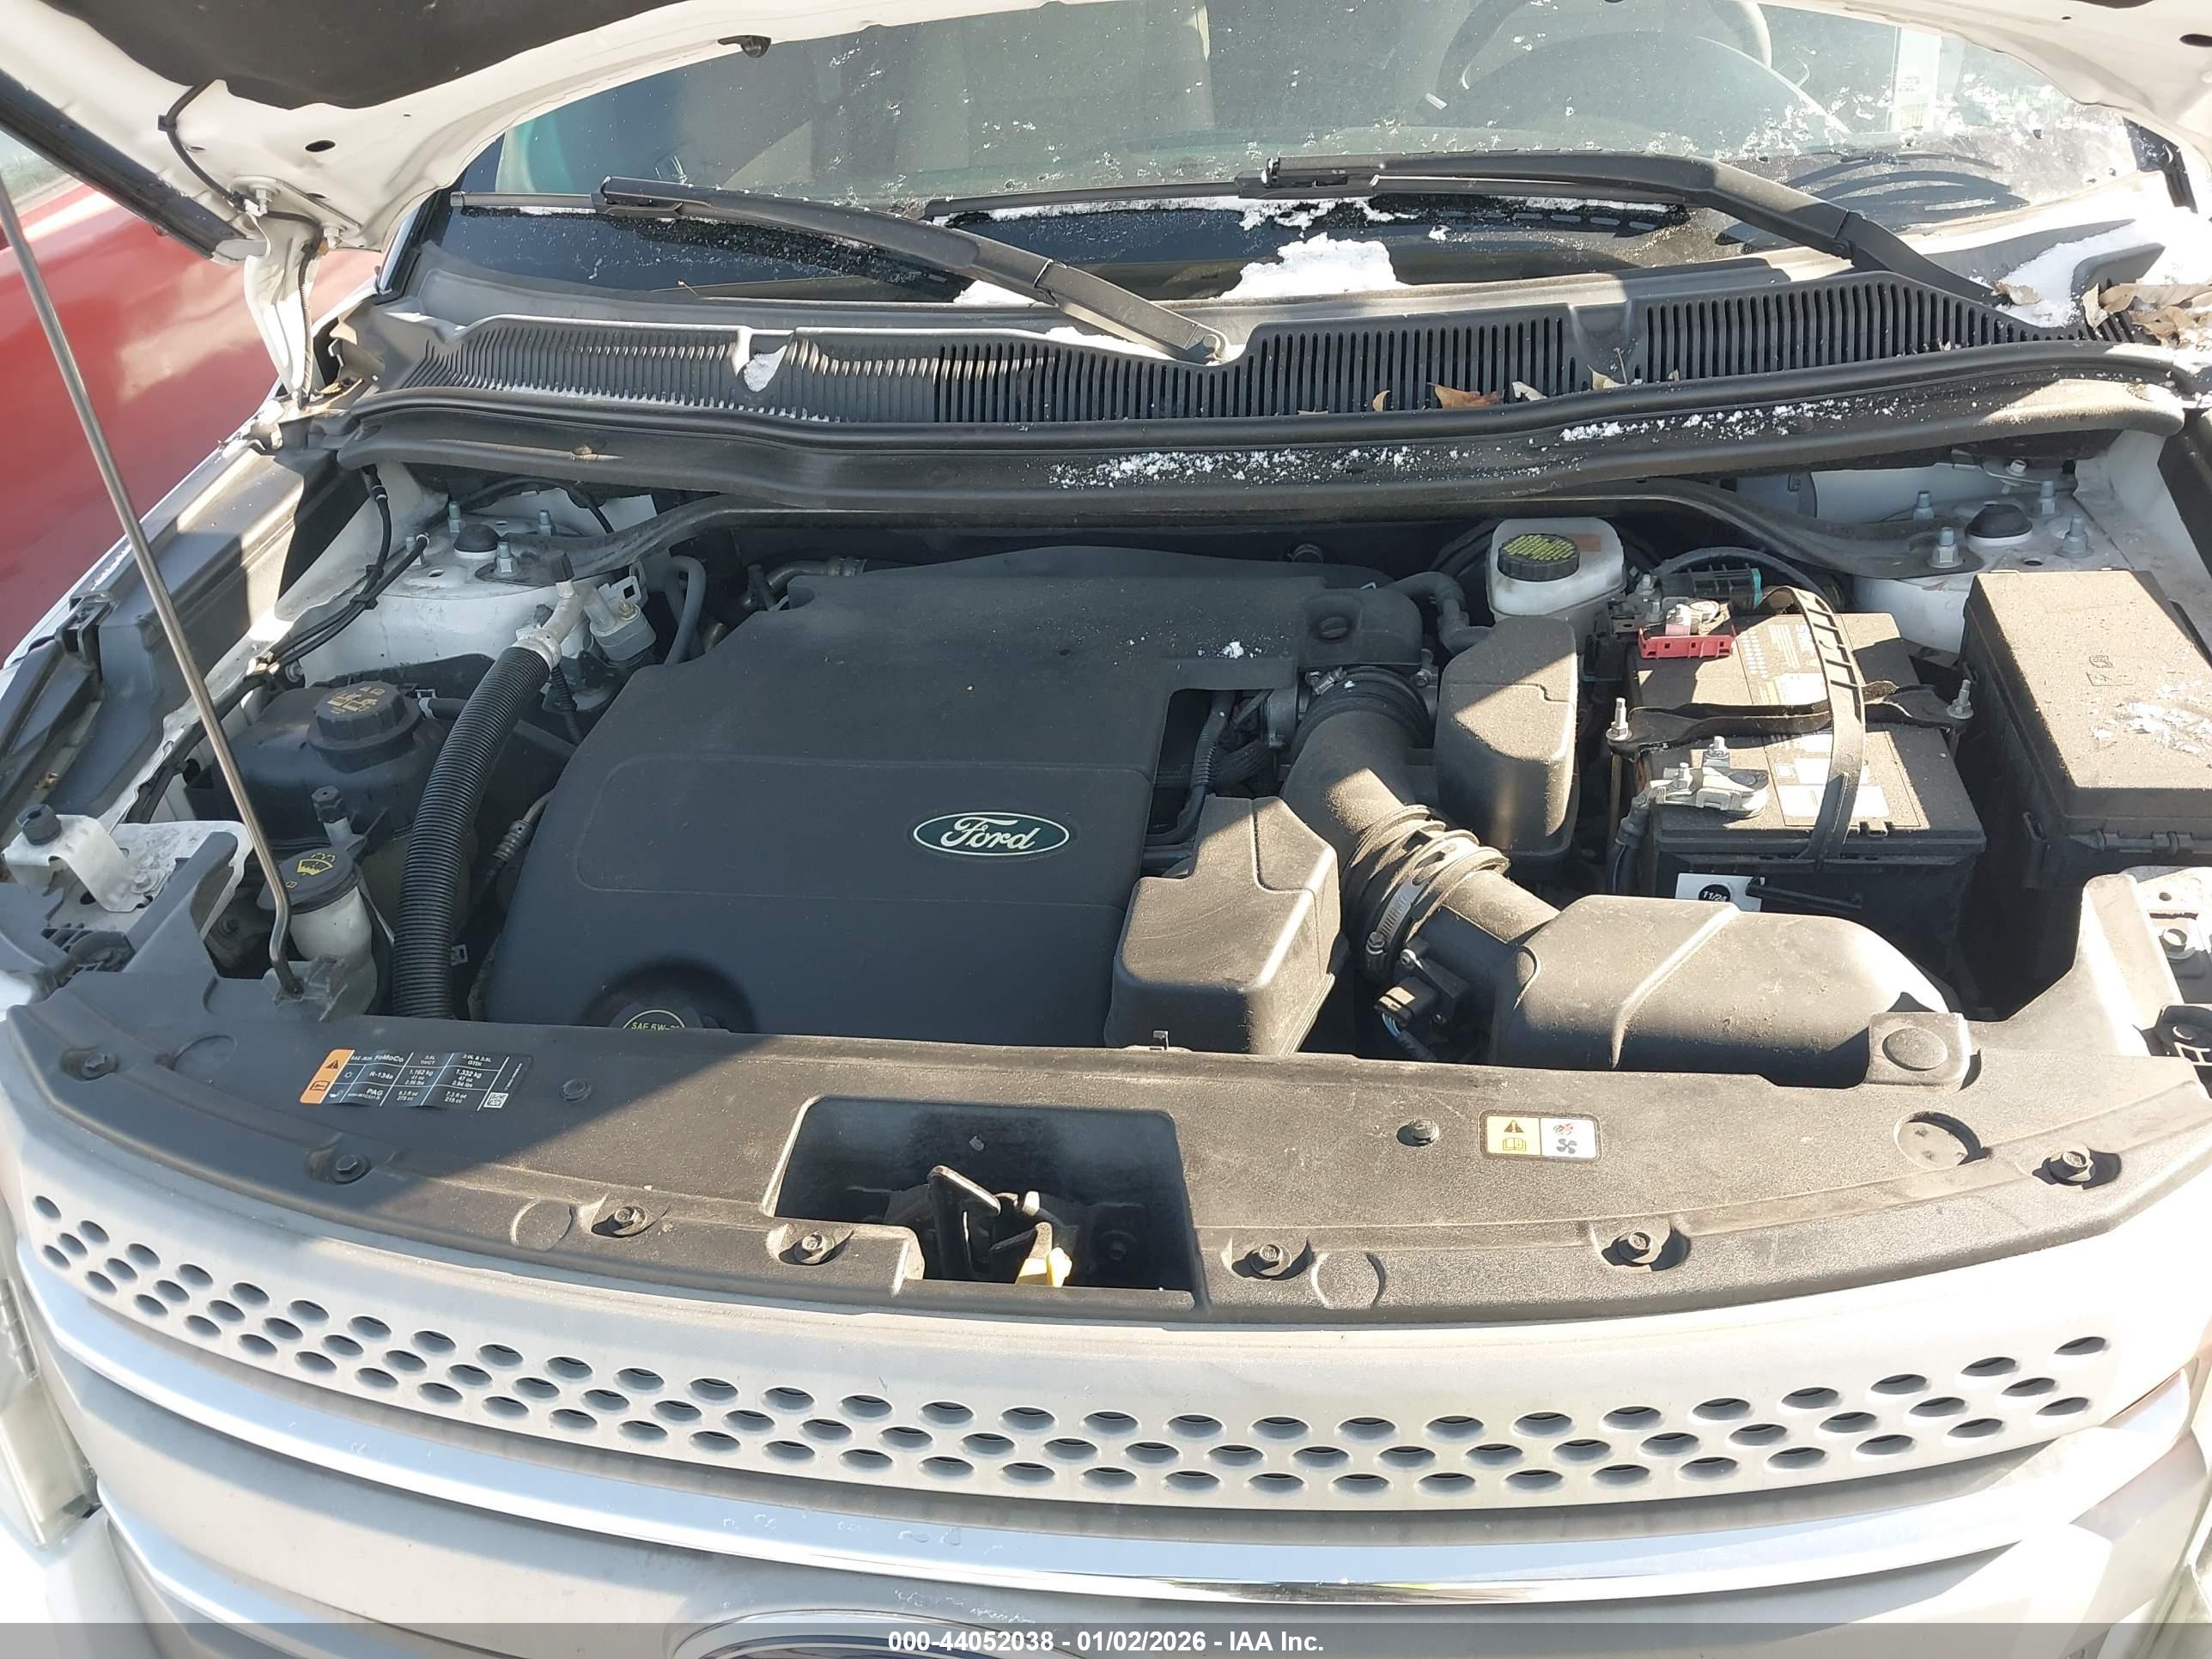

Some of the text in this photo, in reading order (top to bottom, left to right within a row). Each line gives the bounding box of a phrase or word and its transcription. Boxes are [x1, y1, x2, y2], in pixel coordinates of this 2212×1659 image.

[940, 817, 1042, 850] Ford
[1703, 890, 1727, 902] 11/24
[631, 1022, 648, 1030] SAE
[374, 1054, 404, 1063] FoMoCo
[369, 1070, 394, 1079] R-134a
[455, 1068, 474, 1077] 1.332
[366, 1087, 384, 1097] PAG
